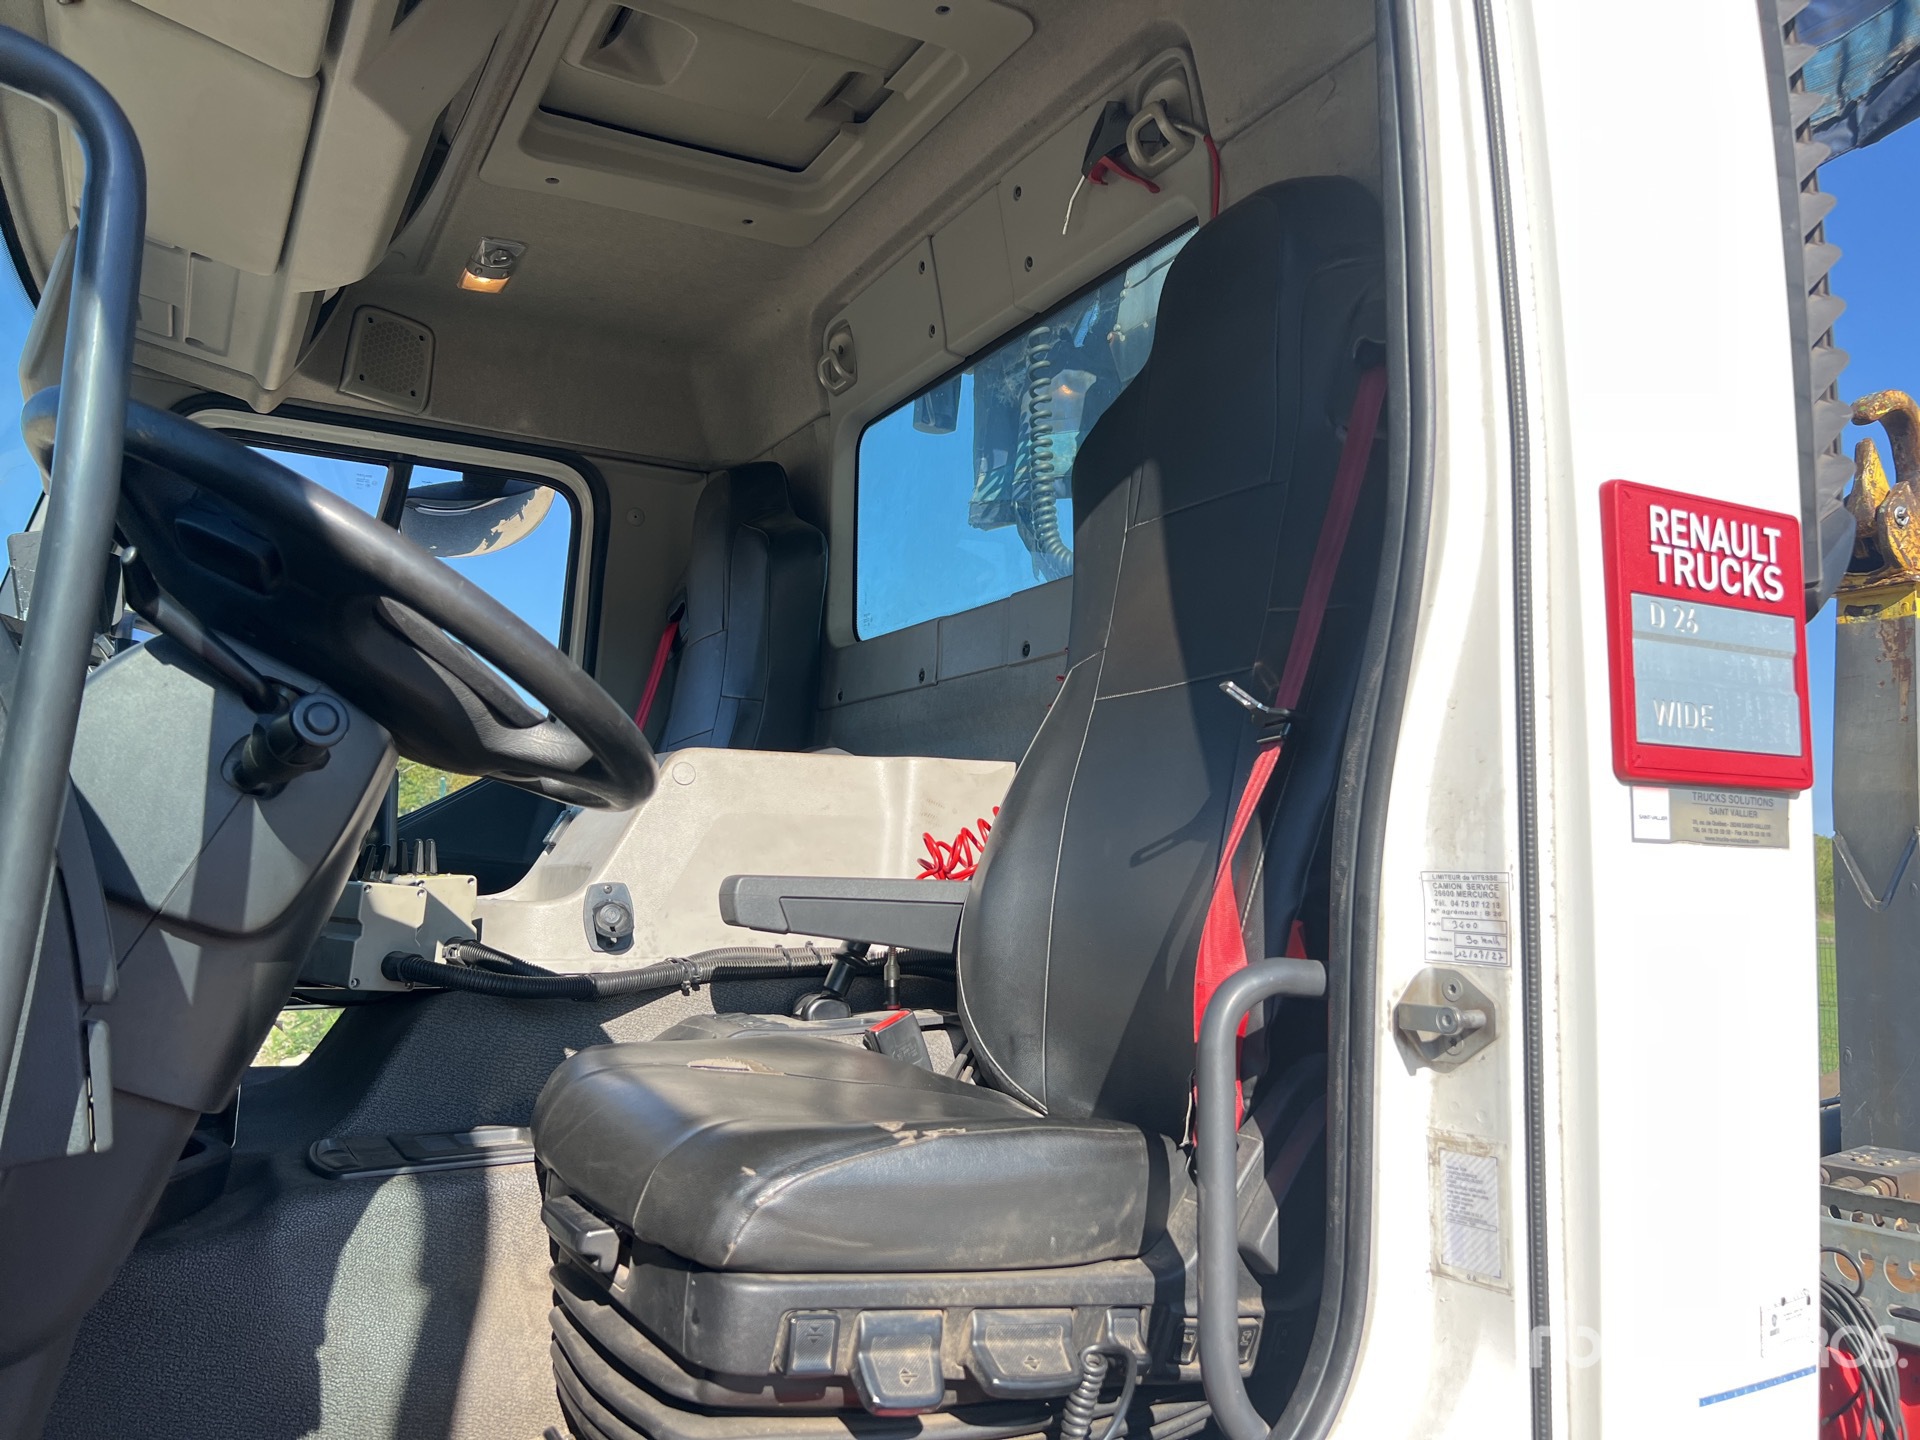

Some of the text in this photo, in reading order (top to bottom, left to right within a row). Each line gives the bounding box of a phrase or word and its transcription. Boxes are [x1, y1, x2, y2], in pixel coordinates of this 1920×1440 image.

[1649, 504, 1781, 563] RENAULT
[1650, 544, 1784, 602] TRUCKS
[1650, 601, 1699, 634] D 26
[1653, 698, 1714, 732] WIDE
[1692, 792, 1774, 807] TRUCKS SOLUTIONS
[1709, 807, 1758, 819] SAINT VALLIER
[1456, 891, 1500, 899] MERCUROL
[1466, 883, 1500, 891] SERVICE
